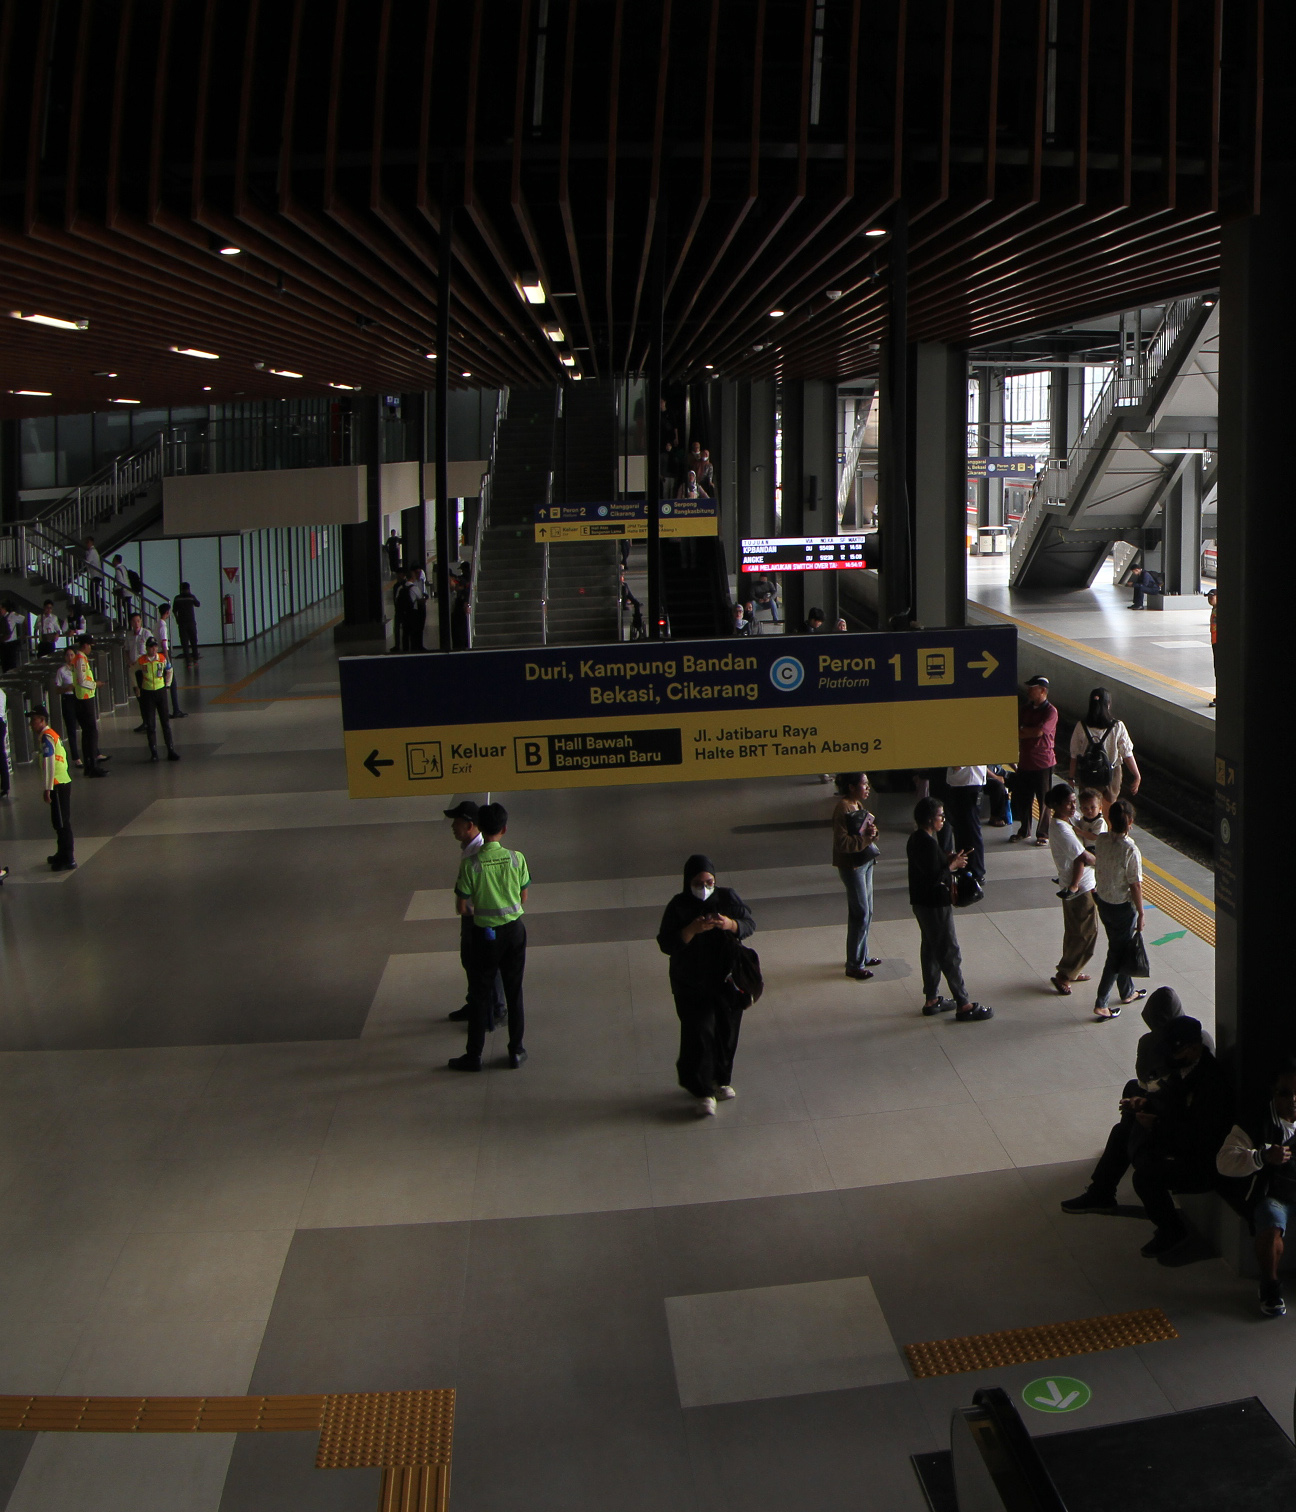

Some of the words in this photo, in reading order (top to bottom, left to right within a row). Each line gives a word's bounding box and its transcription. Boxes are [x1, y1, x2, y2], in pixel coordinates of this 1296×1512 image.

[580, 508, 586, 516] 2
[525, 661, 574, 682] Duri,
[580, 660, 676, 679] Kampung
[683, 654, 758, 672] Bandan
[781, 668, 793, 680] C
[818, 656, 876, 672] Peron
[888, 654, 902, 682] 1
[818, 677, 870, 688] Platform
[590, 684, 660, 704] Bekasi,
[667, 682, 758, 700] Cikarang
[694, 729, 712, 742] Jl.
[716, 727, 778, 741] Jatibaru
[782, 724, 818, 739] Raya
[554, 738, 582, 750] Hall
[586, 735, 632, 748] Bawah
[696, 747, 734, 760] Halte
[740, 745, 768, 758] BRT
[772, 742, 816, 756] Tanah
[821, 740, 869, 754] Abang
[874, 739, 882, 750] 2
[452, 744, 506, 759] Keluar
[525, 742, 542, 766] B
[556, 754, 625, 767] Bangunan
[630, 752, 661, 763] Baru
[452, 763, 472, 774] Exit
